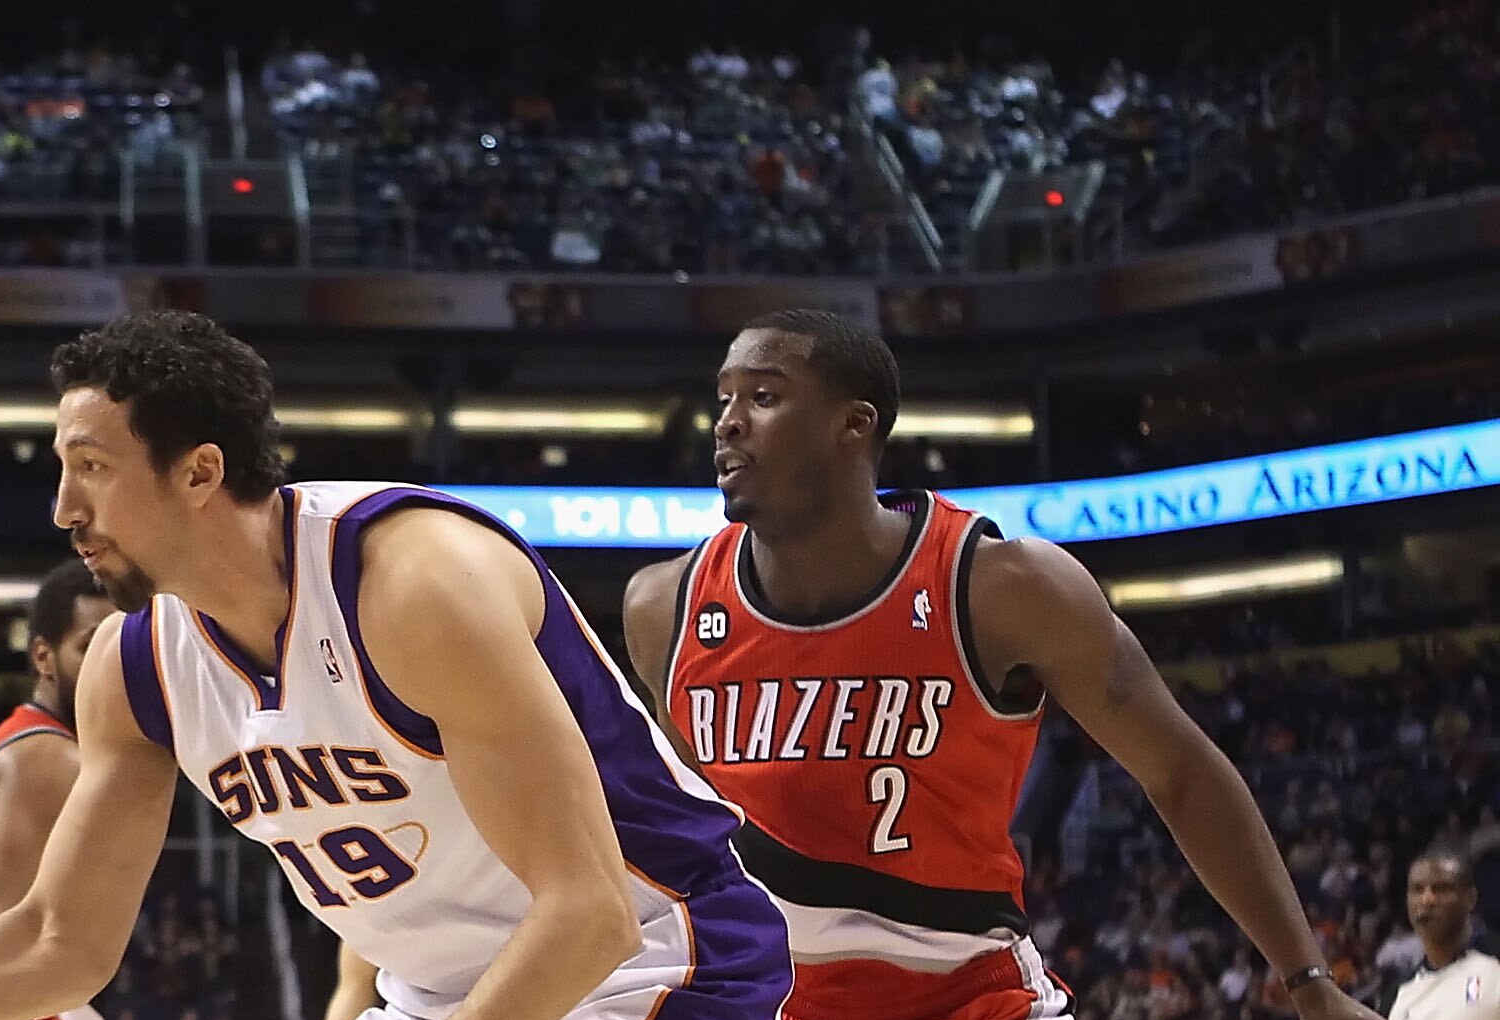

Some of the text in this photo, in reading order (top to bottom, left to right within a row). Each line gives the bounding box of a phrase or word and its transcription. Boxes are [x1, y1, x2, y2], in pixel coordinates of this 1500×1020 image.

[549, 496, 621, 537] 101
[698, 612, 726, 639] 20
[685, 676, 954, 765] BLAZERS
[208, 744, 413, 825] SUNS
[865, 763, 913, 854] 2
[269, 821, 421, 908] 19
